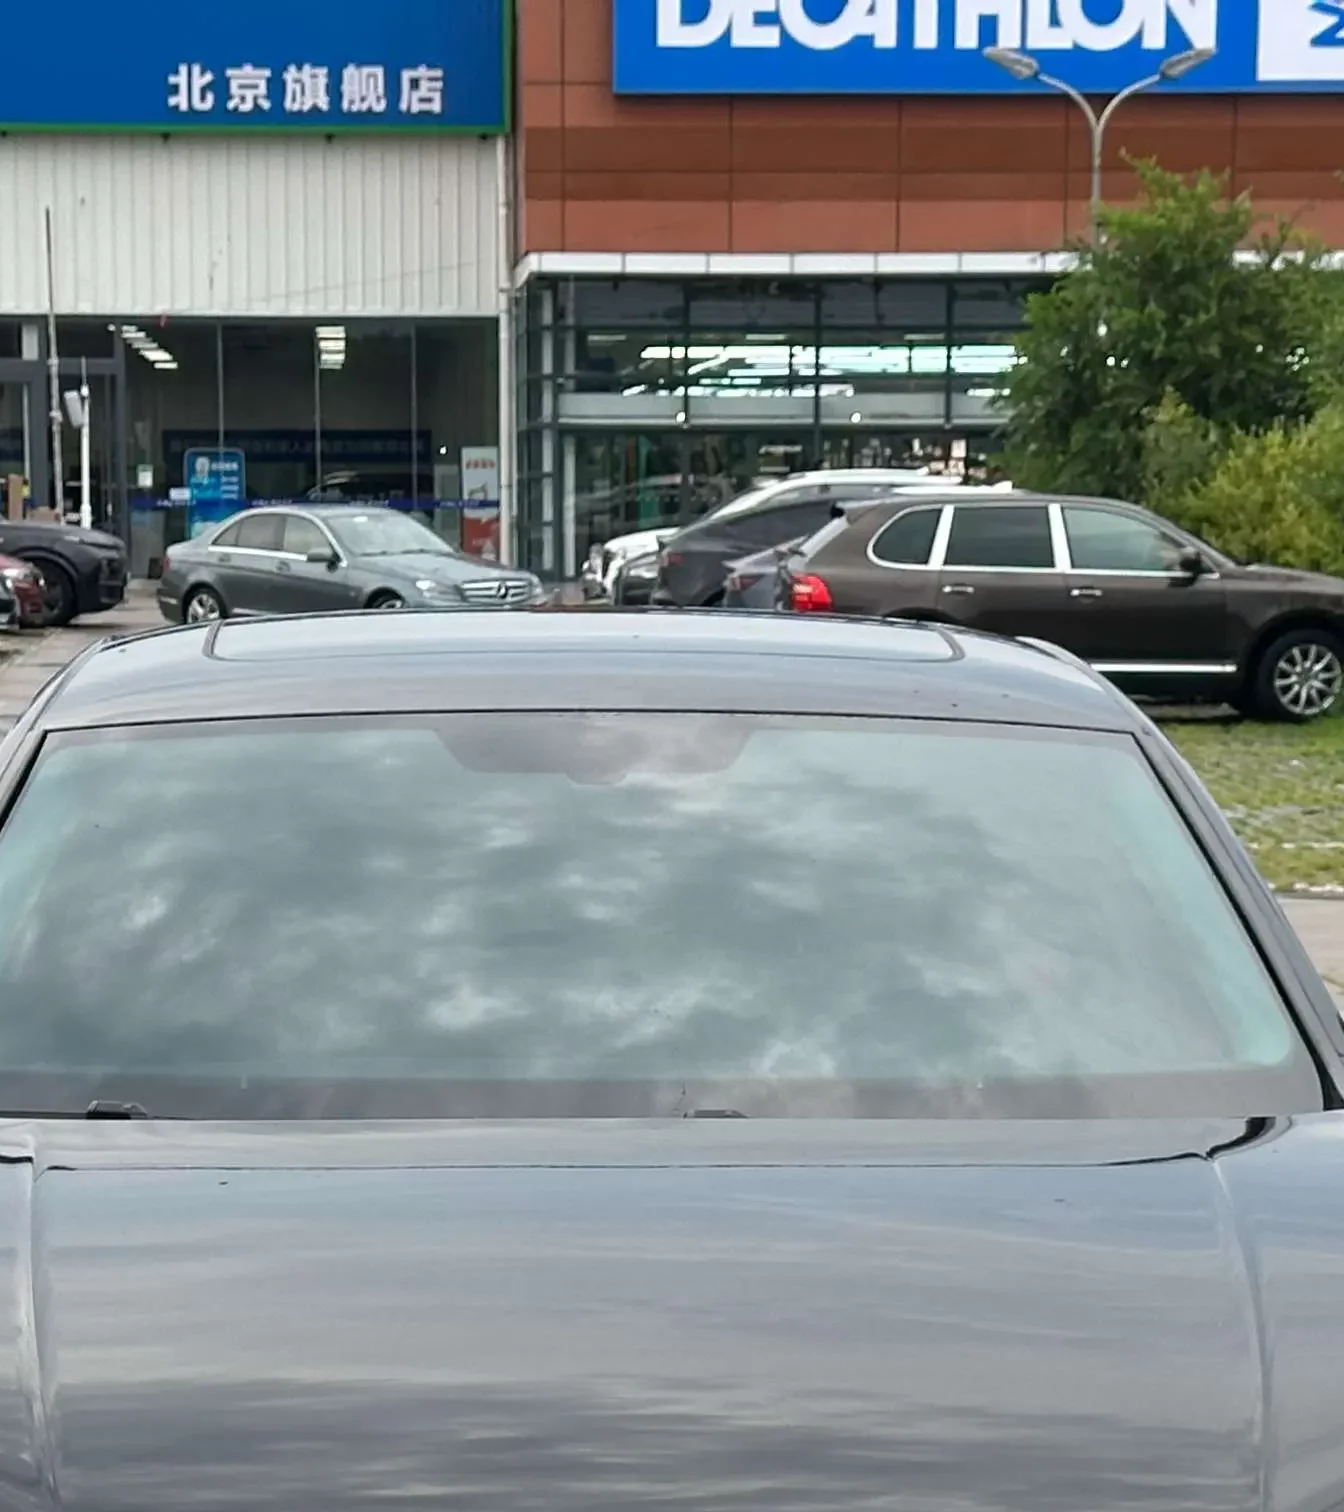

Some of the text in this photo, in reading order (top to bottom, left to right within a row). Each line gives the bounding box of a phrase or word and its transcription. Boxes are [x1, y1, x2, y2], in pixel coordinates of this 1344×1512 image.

[655, 0, 1217, 51] DECATHLON
[166, 63, 445, 114] 北京旗舰店
